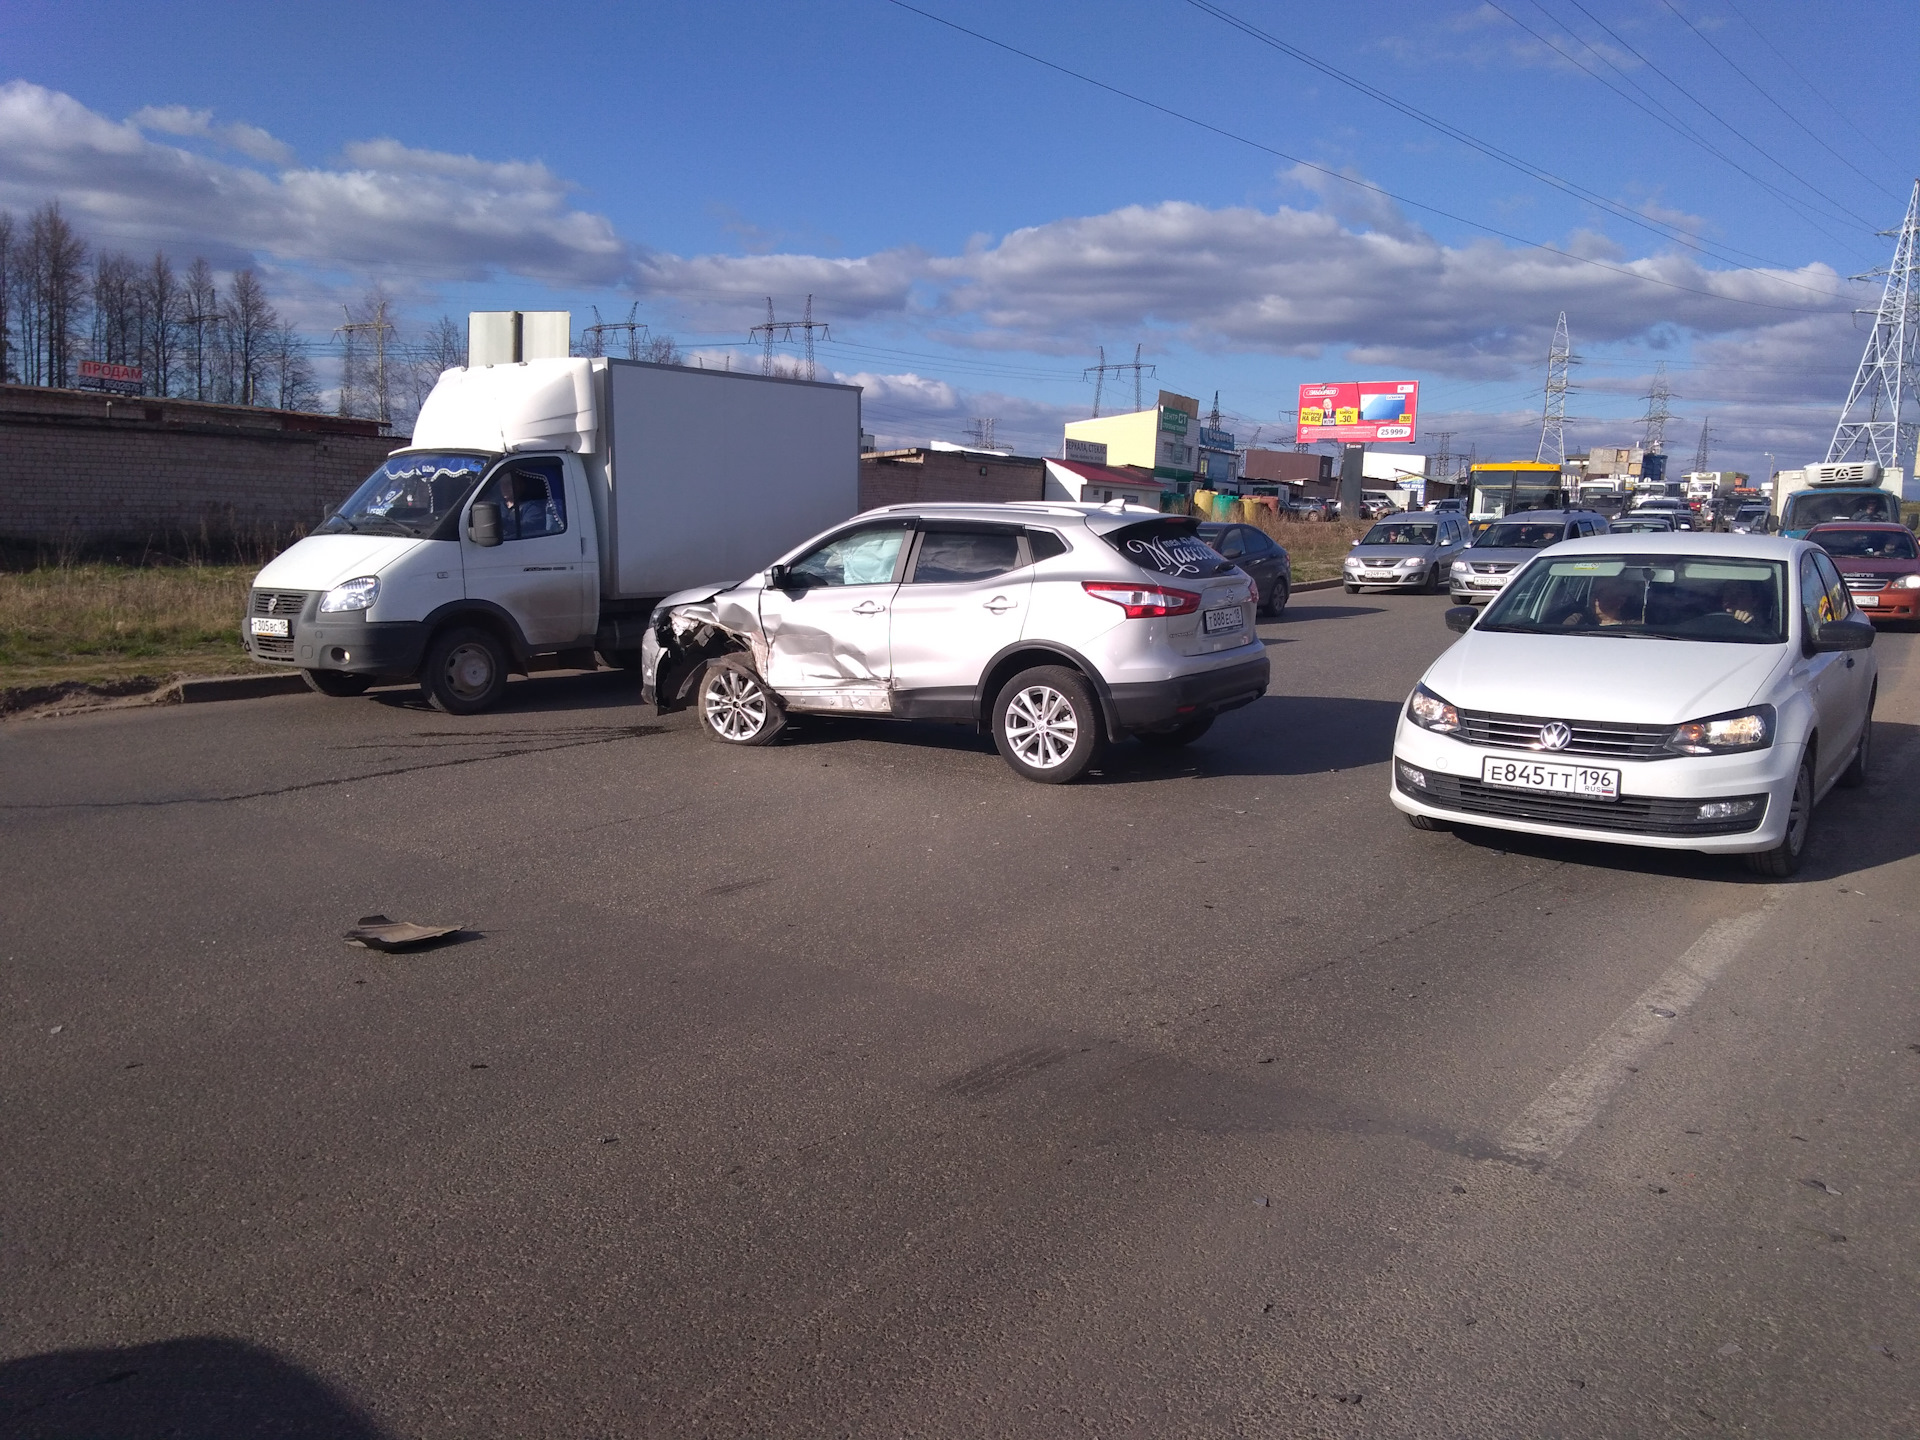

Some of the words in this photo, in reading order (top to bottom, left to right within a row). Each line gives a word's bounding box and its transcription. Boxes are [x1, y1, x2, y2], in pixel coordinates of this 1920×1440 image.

[82, 362, 142, 379] ПРОДАМ
[1208, 611, 1233, 628] Т888ЕС
[1490, 763, 1573, 789] Е845ТТ
[1579, 769, 1612, 787] 196
[1584, 785, 1601, 793] RUS
